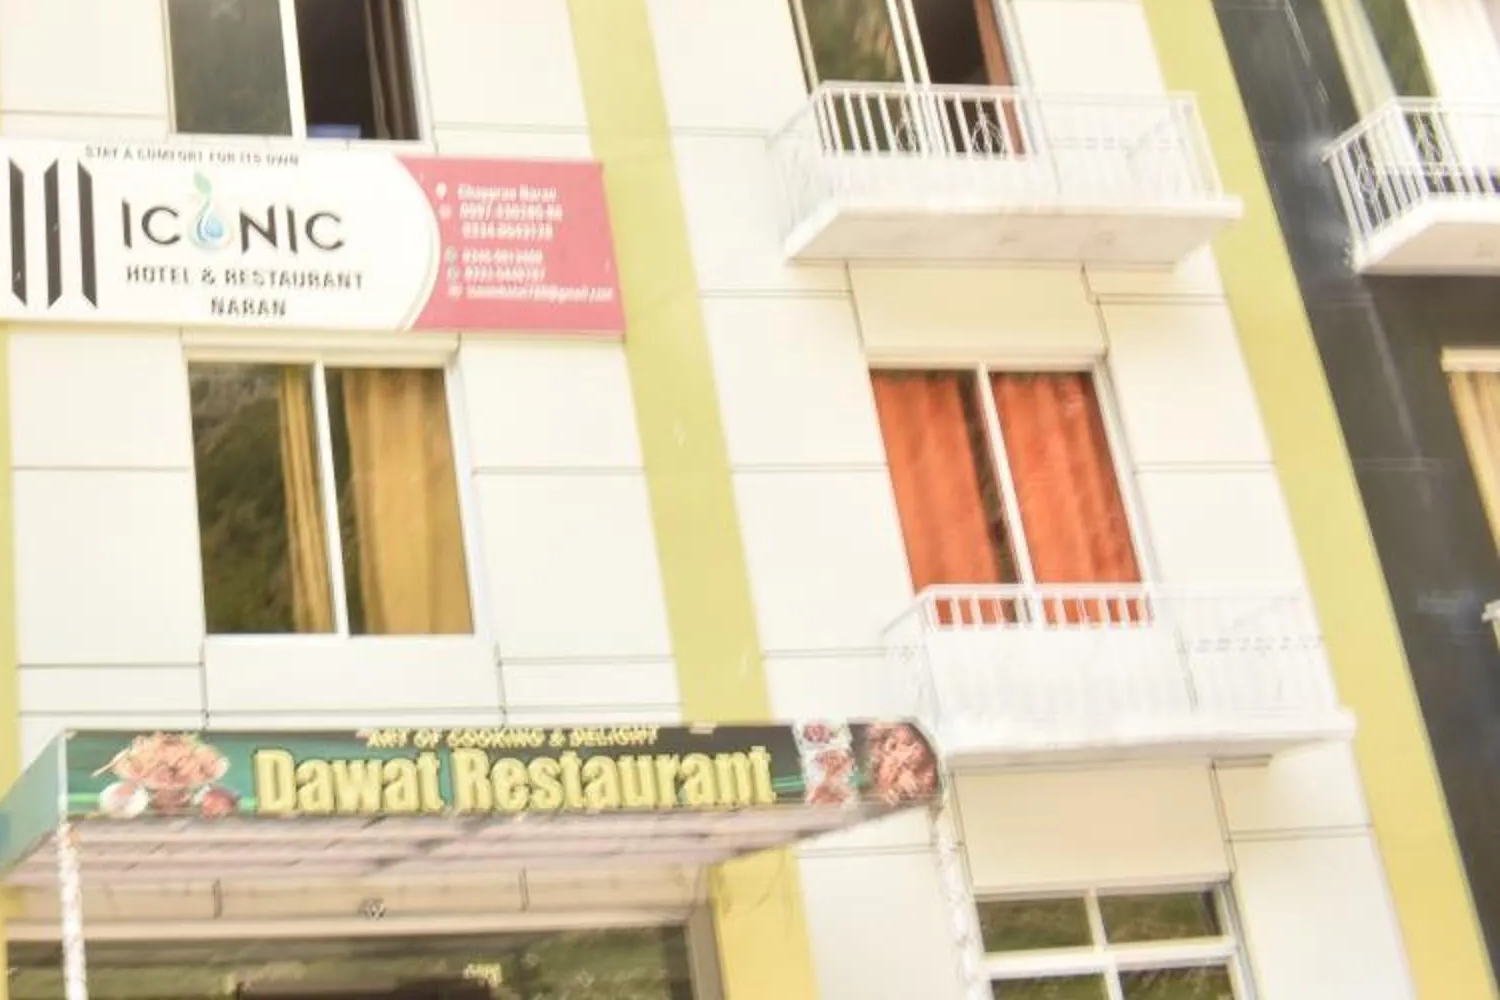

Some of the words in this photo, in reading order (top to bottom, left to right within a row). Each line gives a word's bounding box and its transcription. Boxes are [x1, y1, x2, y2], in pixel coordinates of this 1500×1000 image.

[209, 151, 236, 164] FOR
[120, 195, 346, 255] ICONIC
[126, 264, 190, 285] HOTEL
[200, 266, 217, 285] &
[224, 268, 364, 290] RESTAURANT
[210, 296, 287, 317] NARAN
[366, 728, 408, 748] ART
[413, 727, 442, 747] OF
[446, 727, 546, 748] COOKING
[548, 728, 566, 747] &
[569, 725, 660, 747] DELIGHT
[254, 748, 448, 815] Dawat
[450, 745, 777, 813] Restaurant
